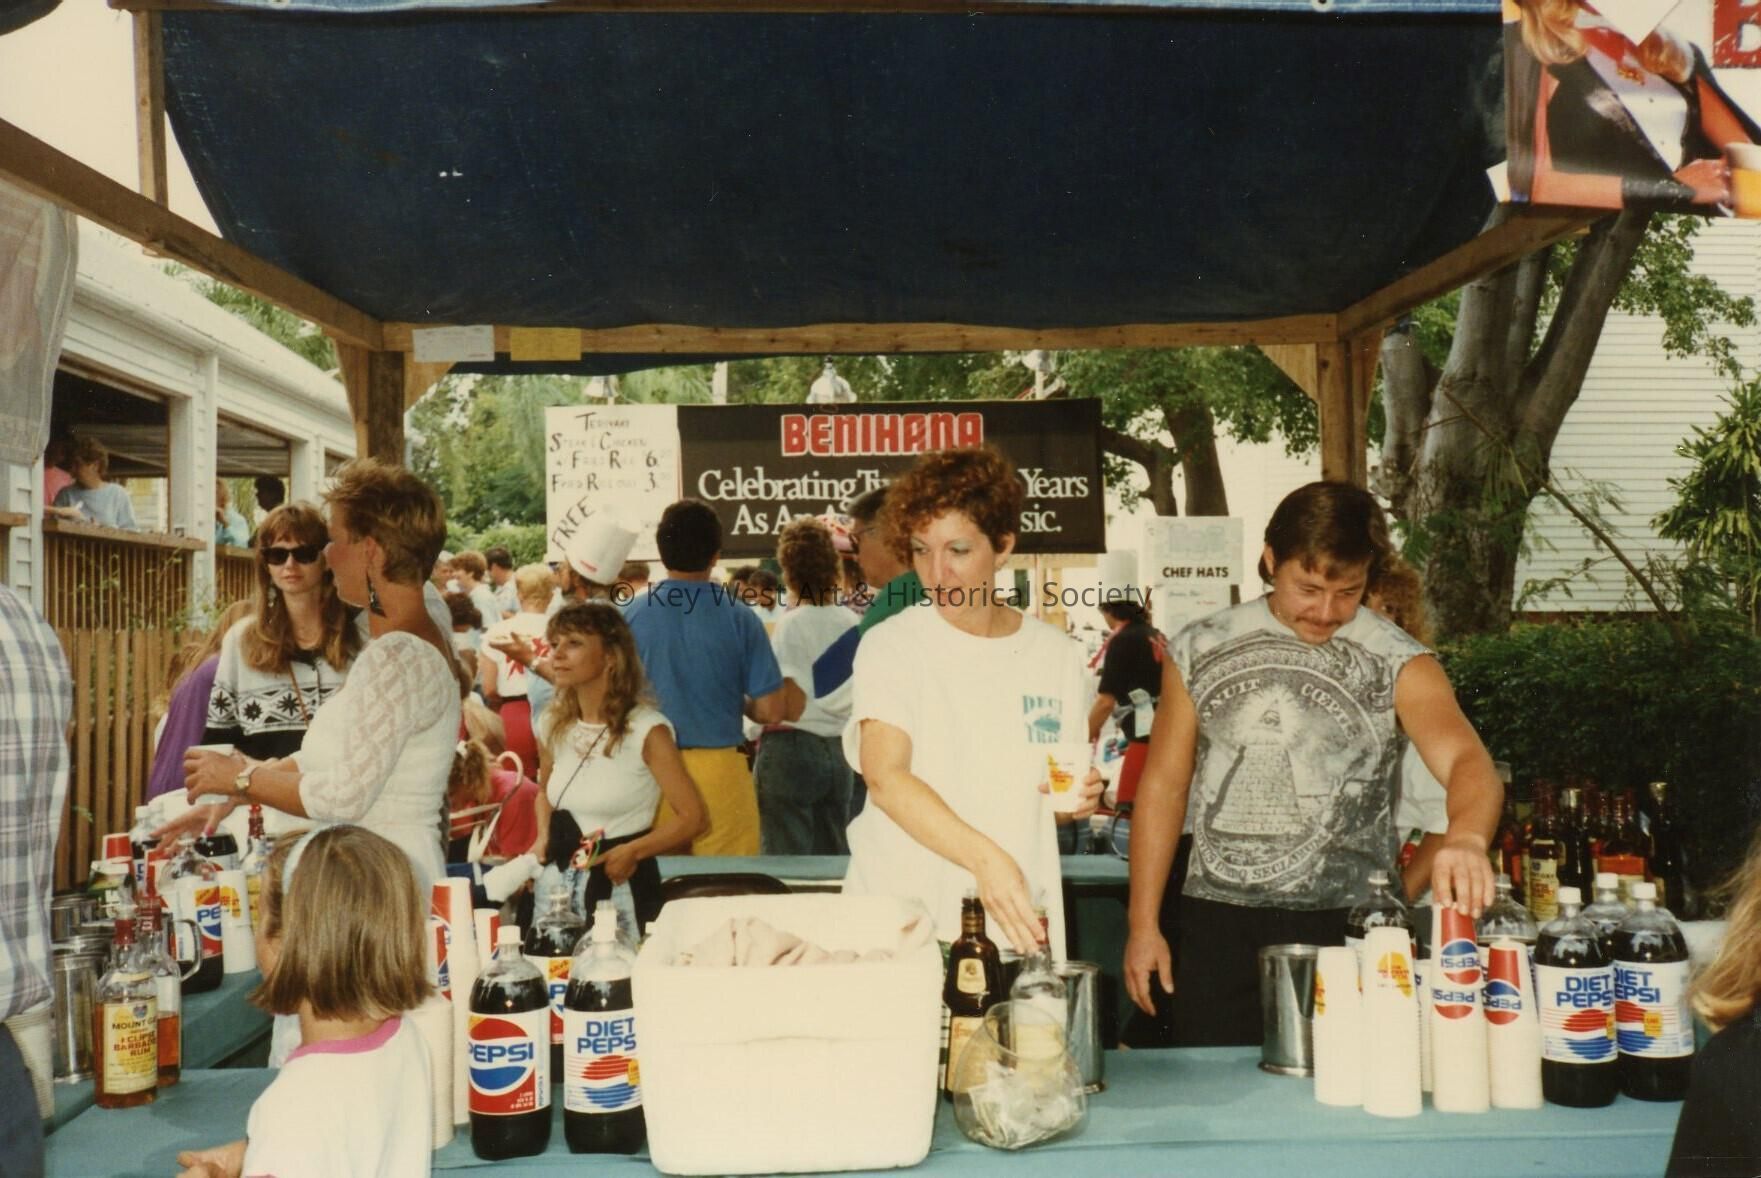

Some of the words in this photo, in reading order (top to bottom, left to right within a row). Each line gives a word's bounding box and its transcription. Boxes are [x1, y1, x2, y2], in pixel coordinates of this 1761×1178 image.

[698, 466, 858, 512] Celebrating
[1017, 468, 1089, 499] Years
[731, 504, 769, 535] As
[1019, 503, 1062, 533] sic.
[1162, 566, 1193, 578] CHEF
[1196, 566, 1229, 578] HATS
[1565, 974, 1611, 992] DIET
[1433, 989, 1476, 1003] PEPS
[1556, 990, 1614, 1008] PEPS
[1614, 984, 1661, 1003] EPSI
[586, 1017, 635, 1037] DIET
[576, 1033, 637, 1054] PEPS
